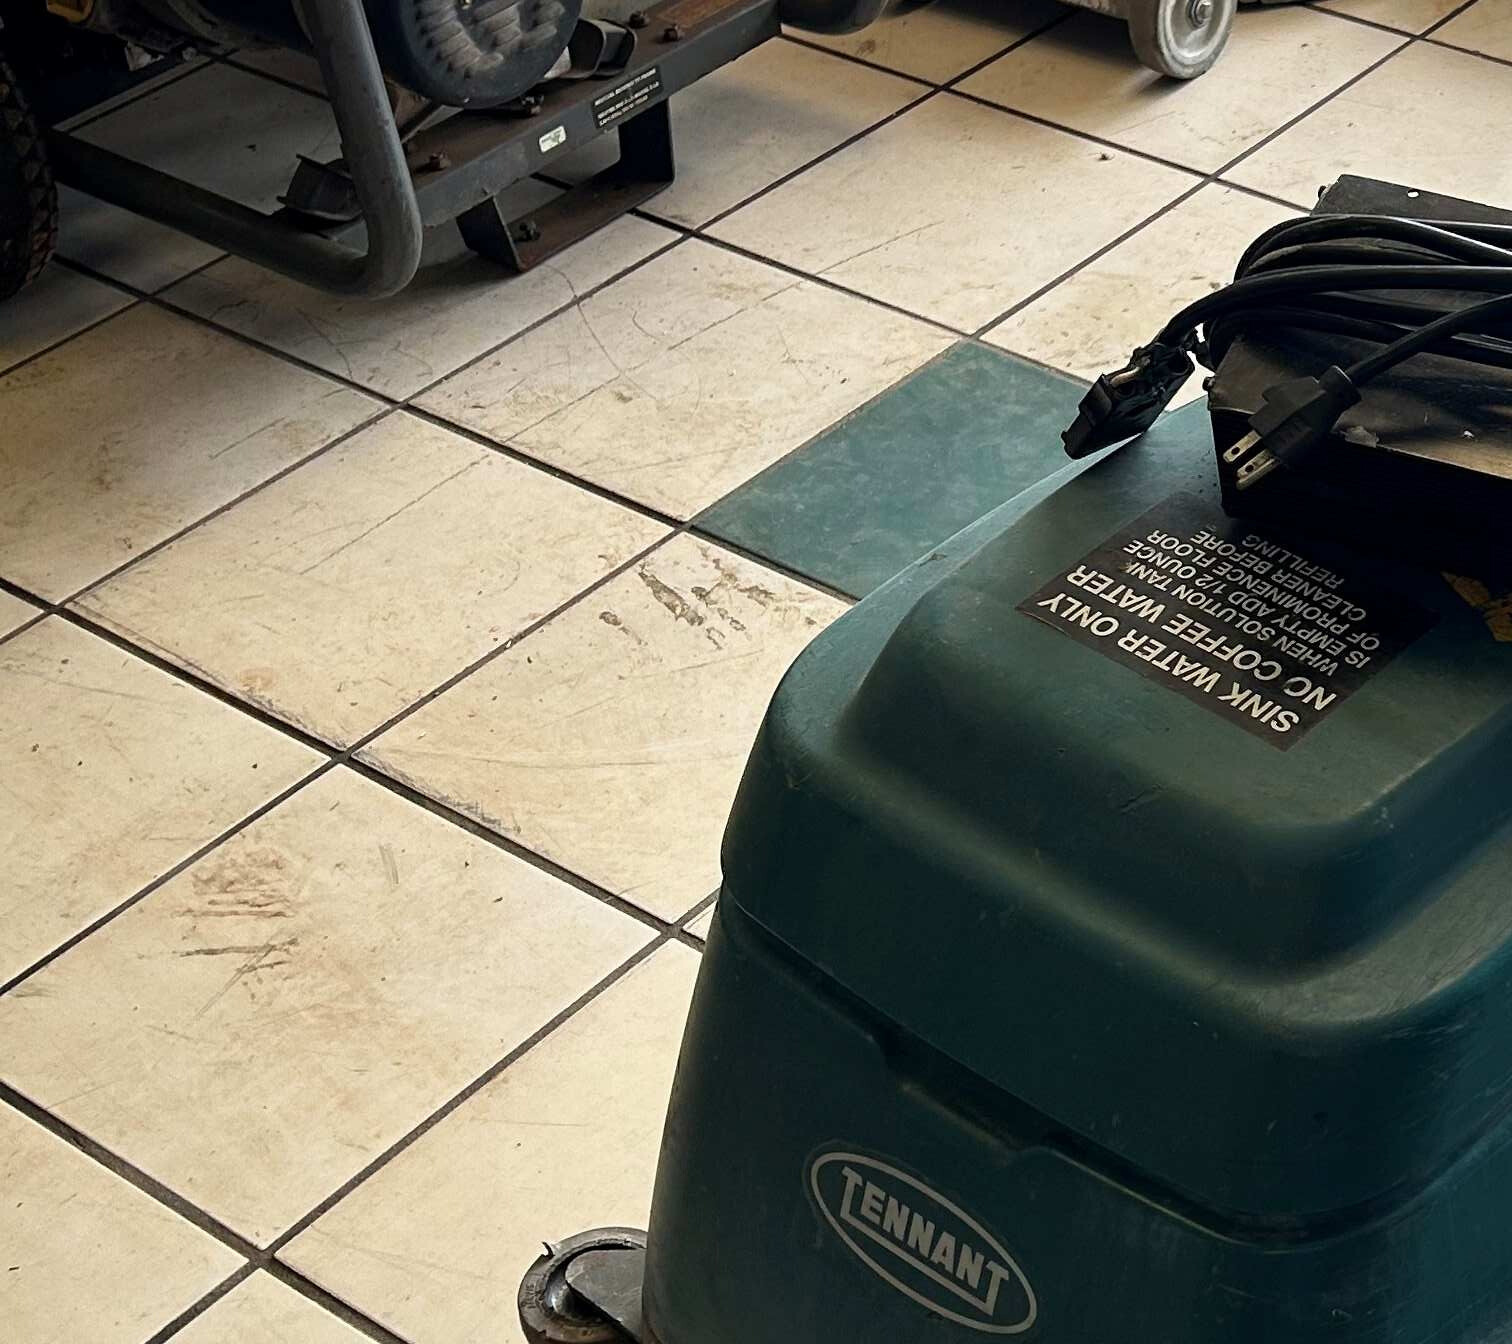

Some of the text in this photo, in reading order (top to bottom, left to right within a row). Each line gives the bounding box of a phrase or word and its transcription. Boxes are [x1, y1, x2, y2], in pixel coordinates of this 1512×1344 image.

[1066, 564, 1166, 624] WATER
[1146, 530, 1380, 651] OF PROMINENCE FLOOR
[1190, 529, 1366, 622] CLEANER BEFORE
[1241, 535, 1346, 590] REFILLING
[1123, 540, 1371, 669] IS EMPTY ADD 1/2 OUNCE
[1171, 585, 1276, 641] SOLUTION
[1037, 592, 1300, 733] SINK WATER ONLY
[1161, 613, 1283, 682] COFFEE
[1272, 636, 1339, 677] WHEN
[840, 1166, 1010, 1316] TENNANT
